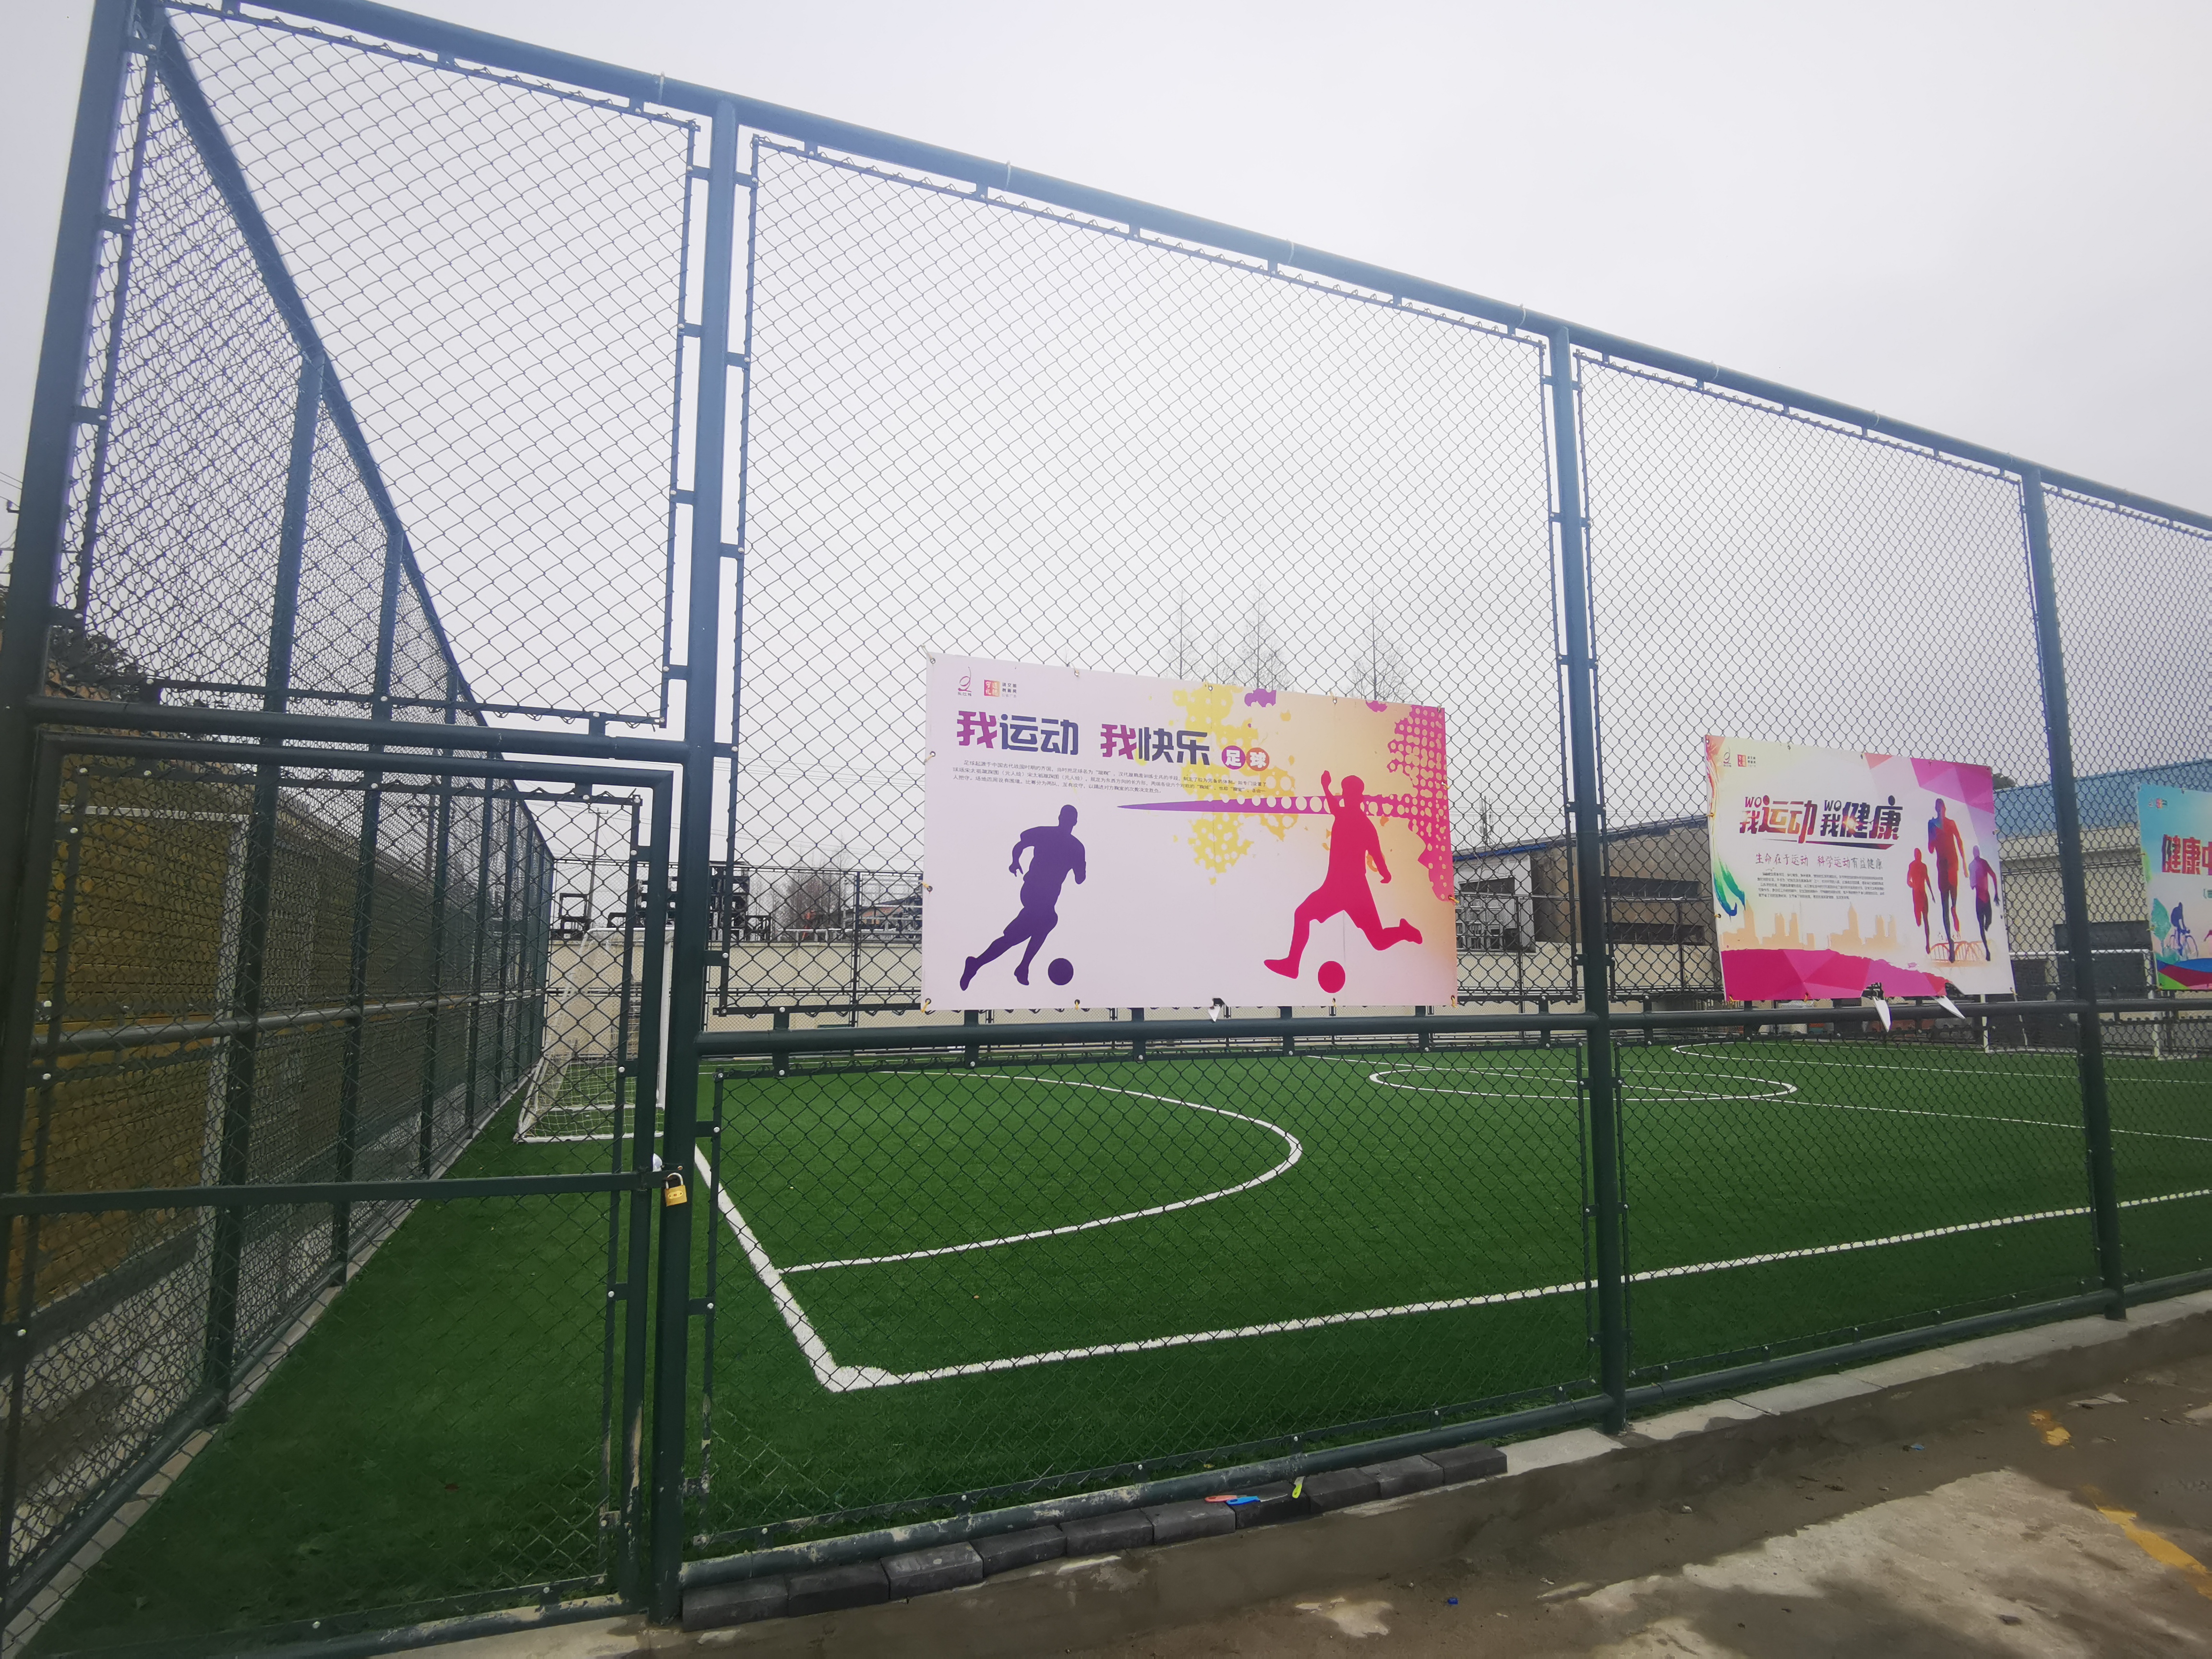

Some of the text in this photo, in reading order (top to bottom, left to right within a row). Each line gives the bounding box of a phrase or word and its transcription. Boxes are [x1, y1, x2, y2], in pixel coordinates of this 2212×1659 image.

[957, 710, 1210, 765] 我运动 我快乐
[1225, 749, 1267, 768] 足球
[1745, 796, 1841, 811] WO WO
[1740, 795, 1903, 844] 我运动 我健康
[1755, 853, 1884, 870] 生命在于运动 科学运动有益健康
